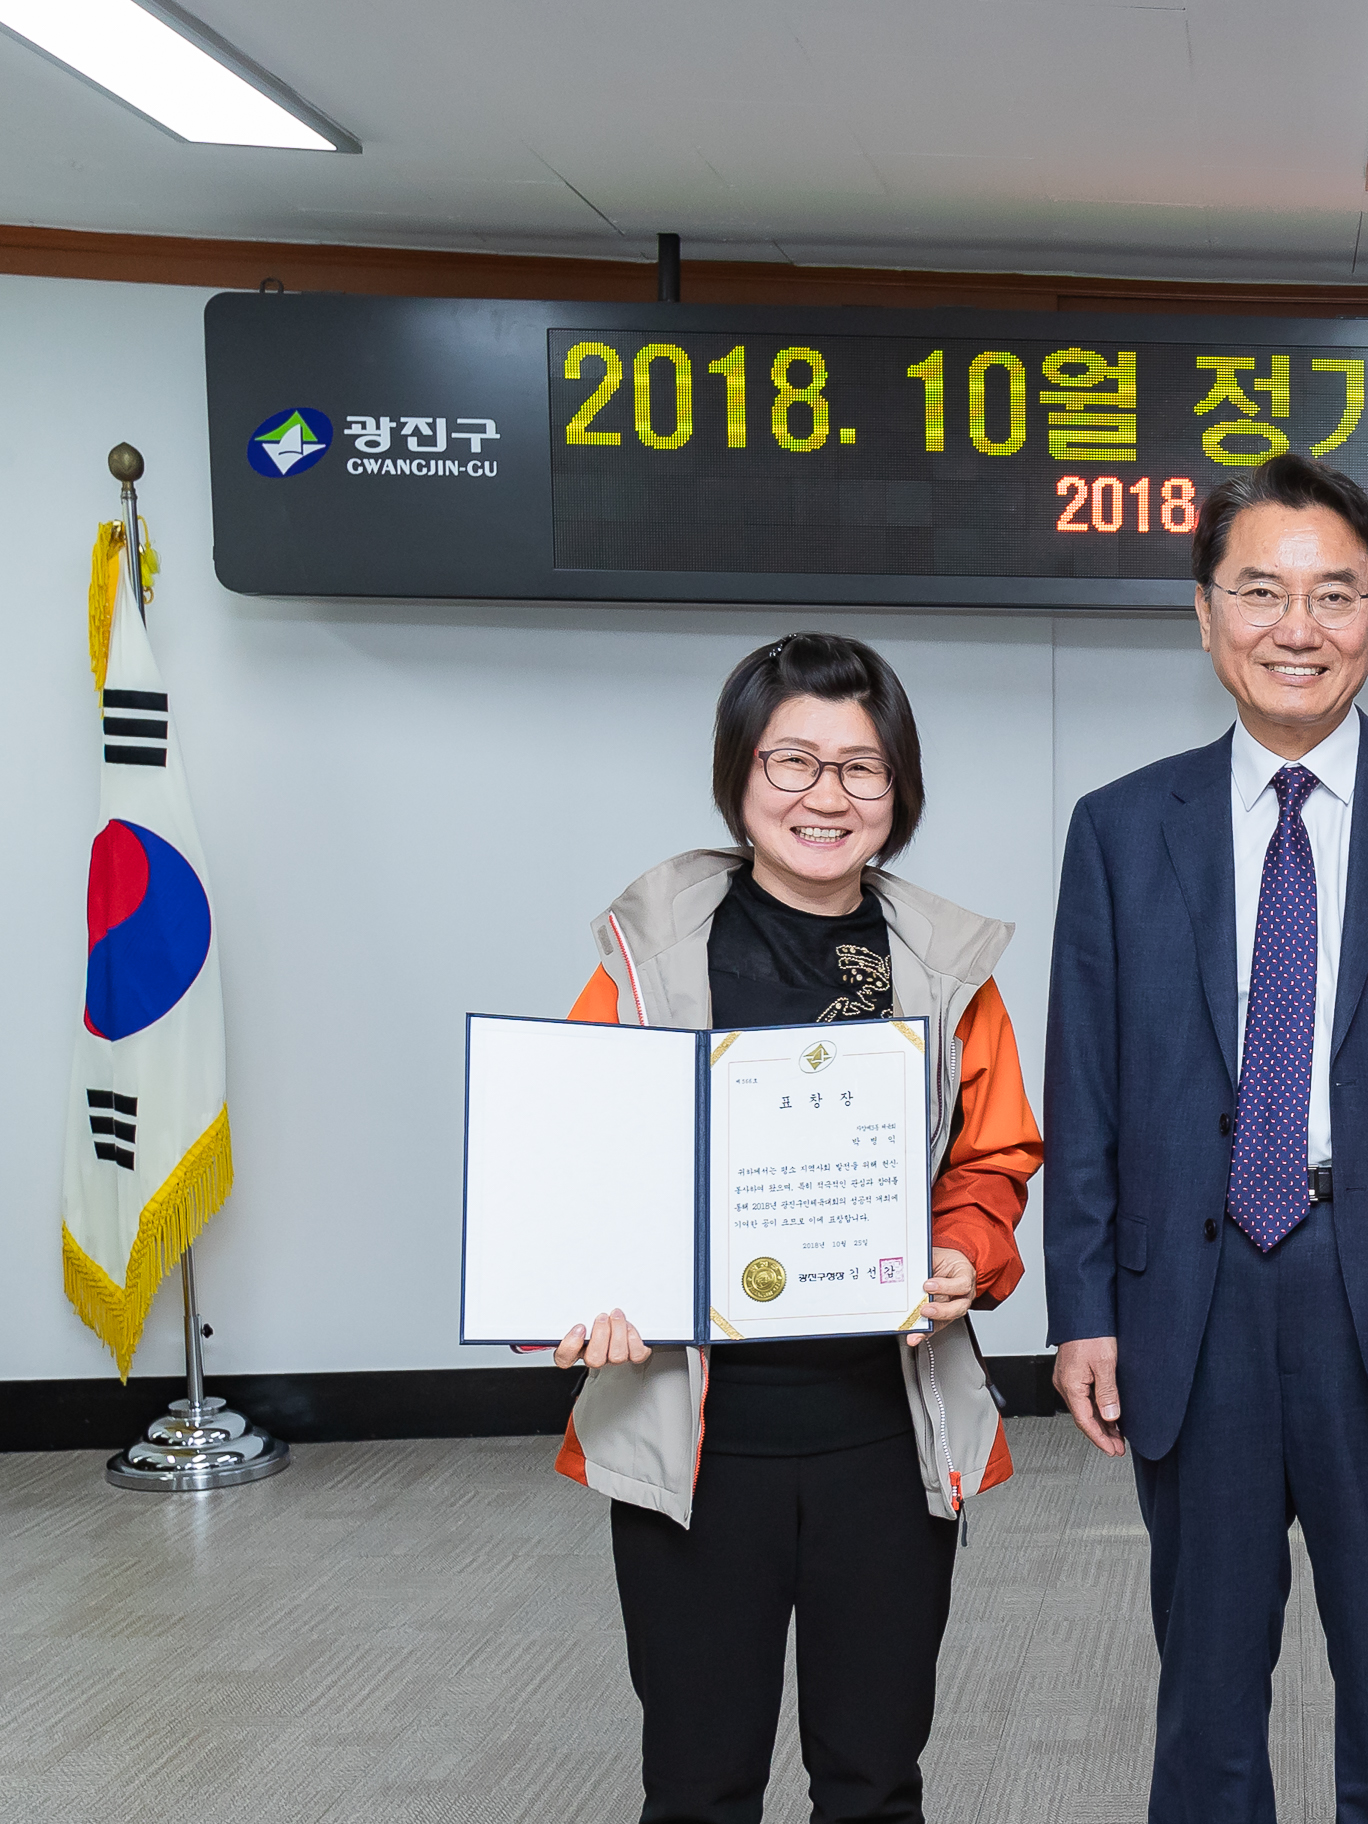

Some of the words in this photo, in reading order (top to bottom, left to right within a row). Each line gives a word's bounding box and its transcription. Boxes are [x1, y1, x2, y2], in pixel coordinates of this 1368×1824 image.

[565, 342, 855, 452] 2018.
[908, 348, 1136, 461] 10월
[344, 416, 500, 453] 광진구
[346, 459, 498, 477] GWANGJIN-GU
[800, 1162, 831, 1173] 지역사회
[850, 1177, 874, 1189] 관심과
[751, 1200, 777, 1211] 2018년
[850, 1195, 872, 1206] 성공적
[761, 1218, 777, 1229] 공이
[808, 1215, 824, 1225] 이에
[802, 1241, 825, 1250] 2018년
[832, 1239, 847, 1248] 10월
[853, 1238, 868, 1247] 25일
